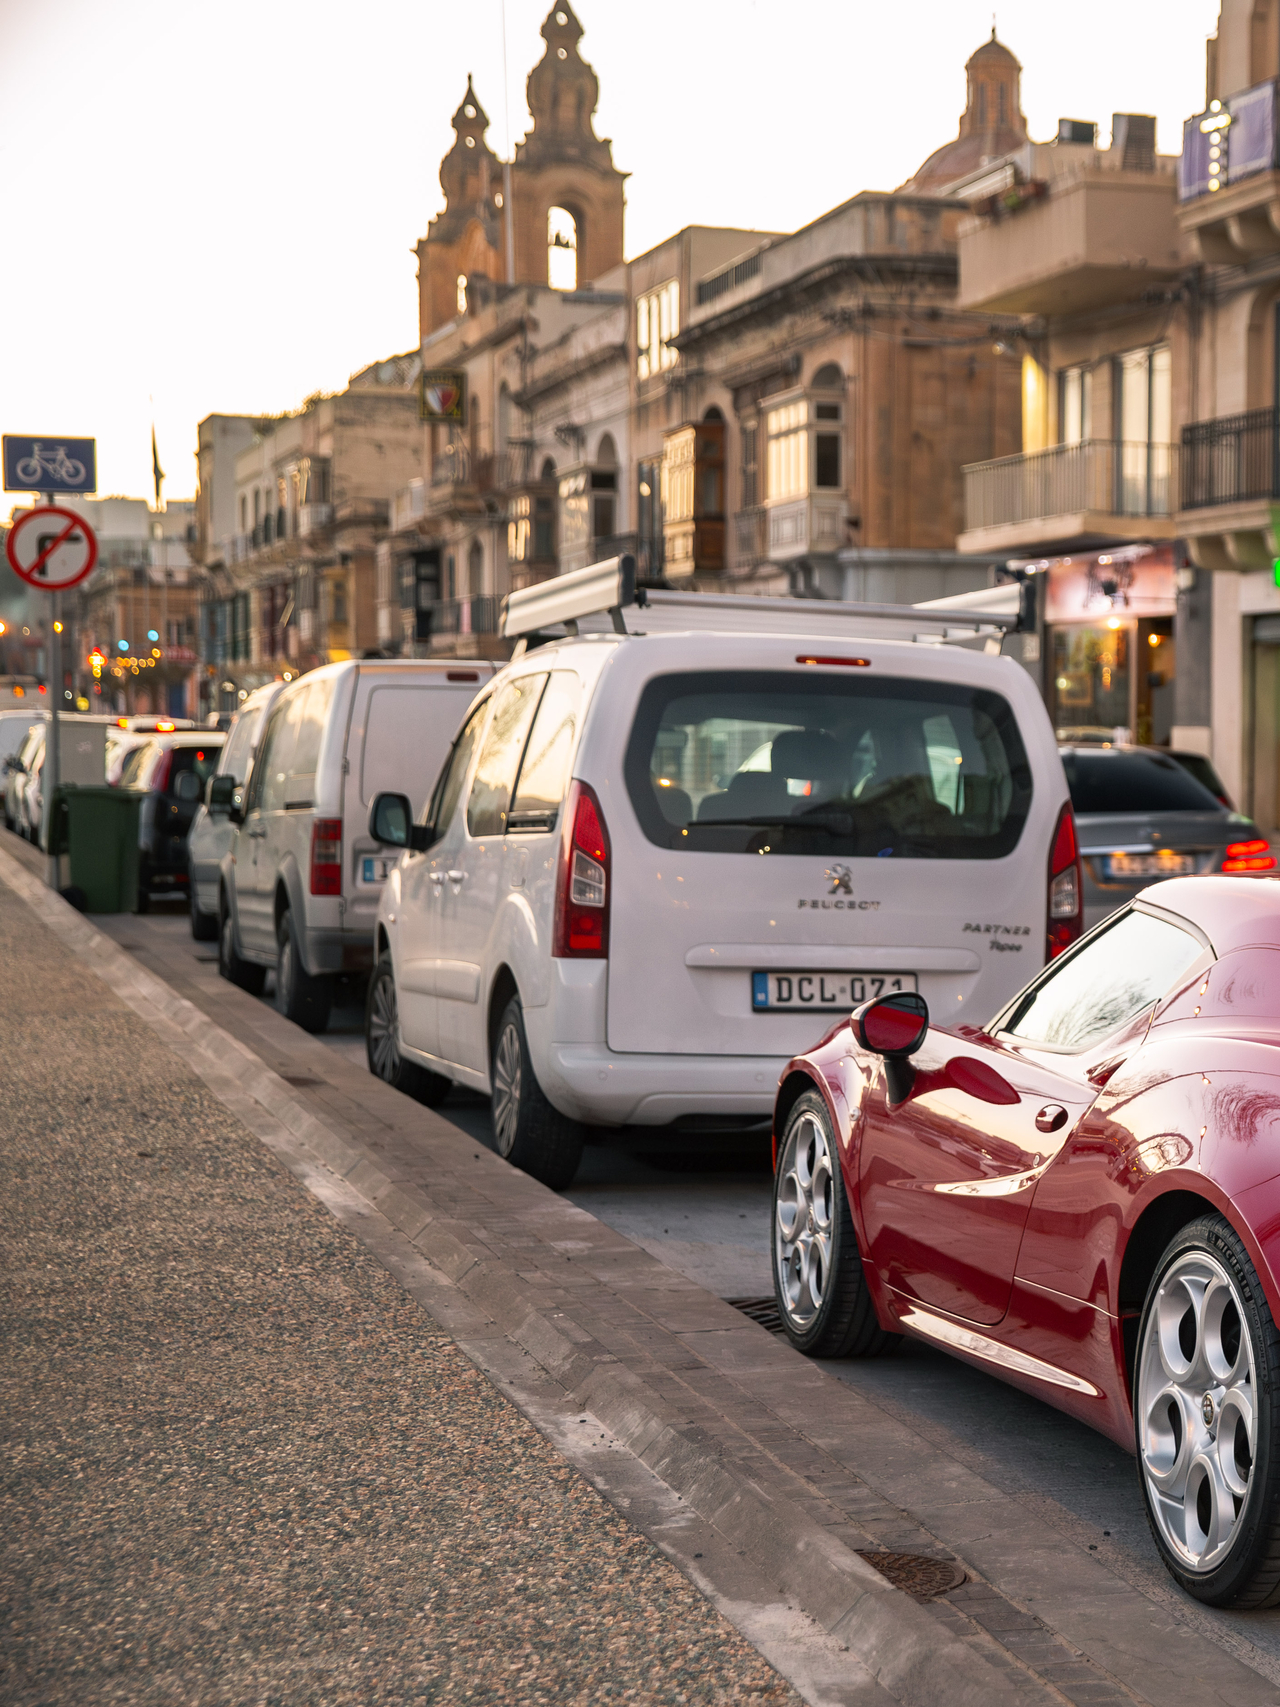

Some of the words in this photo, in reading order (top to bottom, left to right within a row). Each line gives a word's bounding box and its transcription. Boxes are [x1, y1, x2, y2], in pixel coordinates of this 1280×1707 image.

[797, 899, 881, 911] PEUGEOT
[962, 922, 1031, 936] PARTNER
[776, 977, 836, 1002] DCL
[1216, 1238, 1252, 1298] MICHELIN
